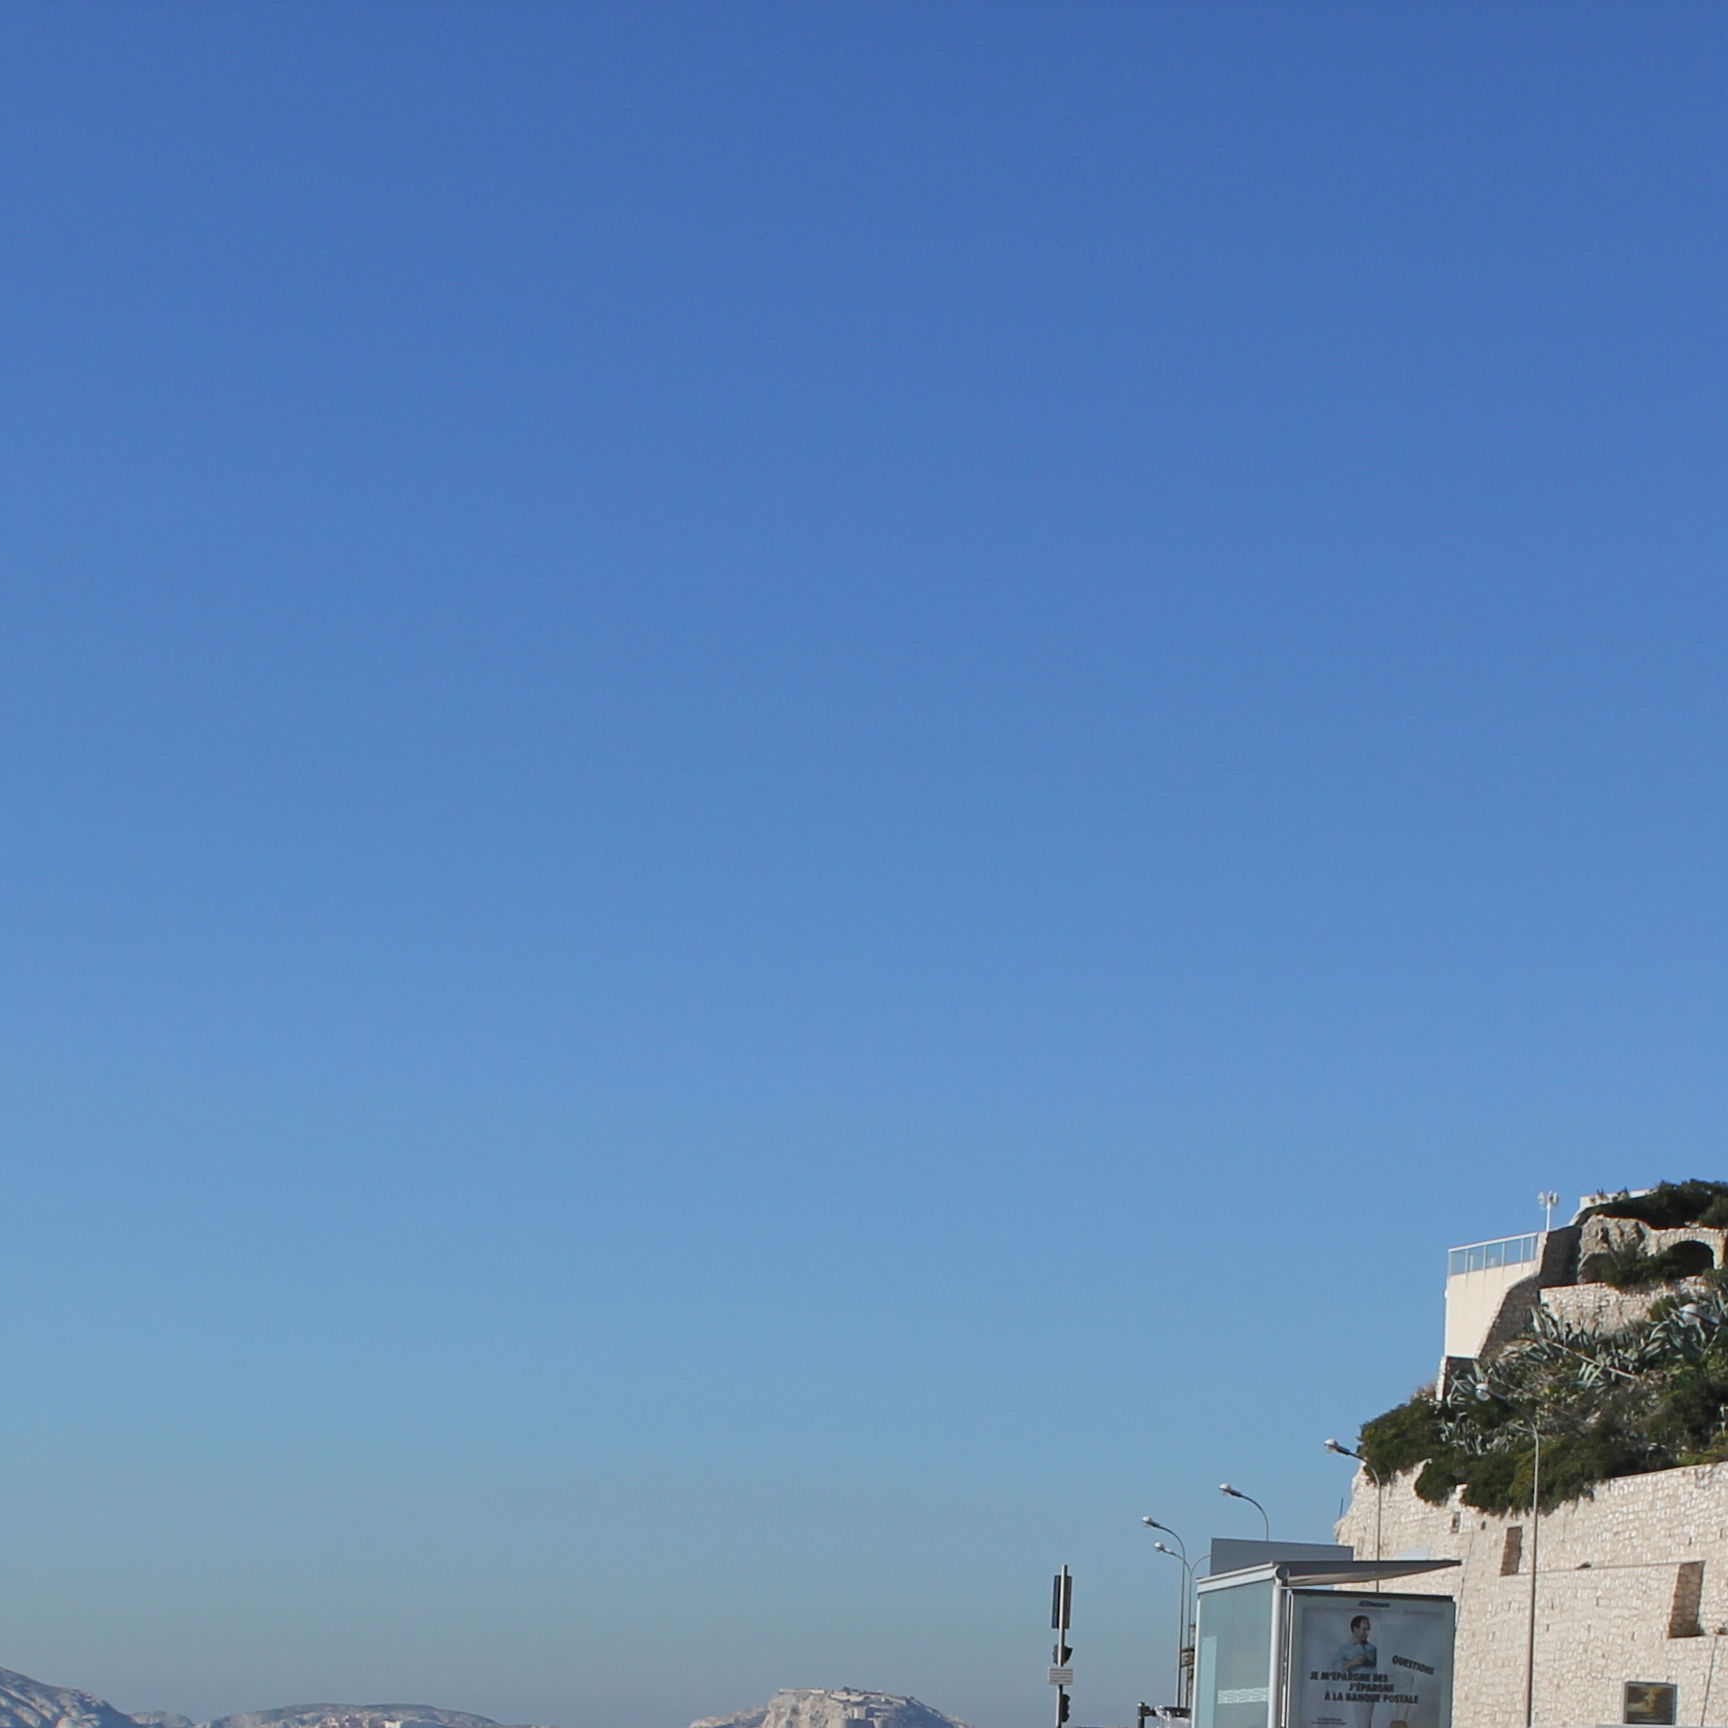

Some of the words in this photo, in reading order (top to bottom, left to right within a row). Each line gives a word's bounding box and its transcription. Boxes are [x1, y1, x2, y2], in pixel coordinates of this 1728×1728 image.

[1392, 1655, 1435, 1675] QUESTIONS
[1373, 1674, 1389, 1682] DES
[1333, 1693, 1344, 1701] LA
[1345, 1693, 1380, 1703] BANQUE
[1383, 1694, 1419, 1704] POSTALE
